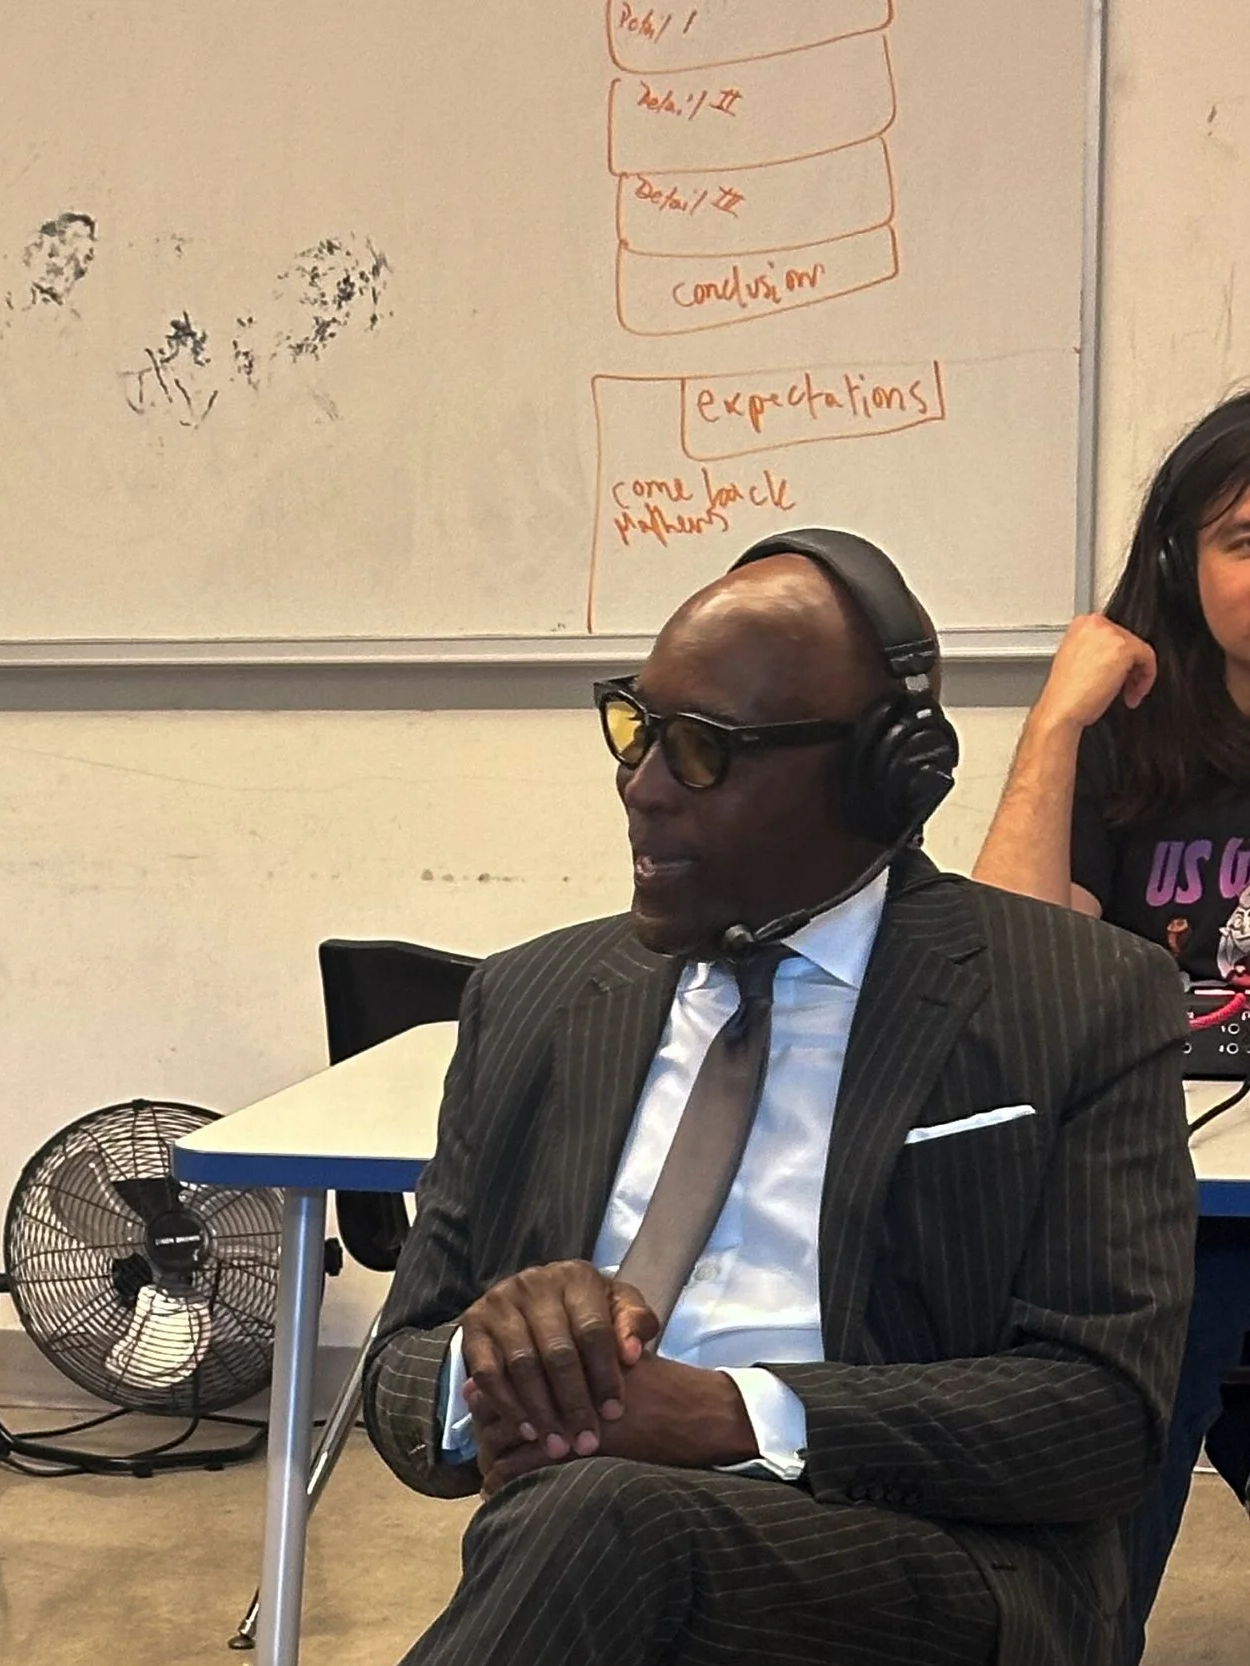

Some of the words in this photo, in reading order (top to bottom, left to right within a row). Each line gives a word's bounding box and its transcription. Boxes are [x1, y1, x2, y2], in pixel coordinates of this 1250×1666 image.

[696, 372, 929, 433] expectations
[701, 466, 796, 511] back
[1146, 839, 1212, 907] US
